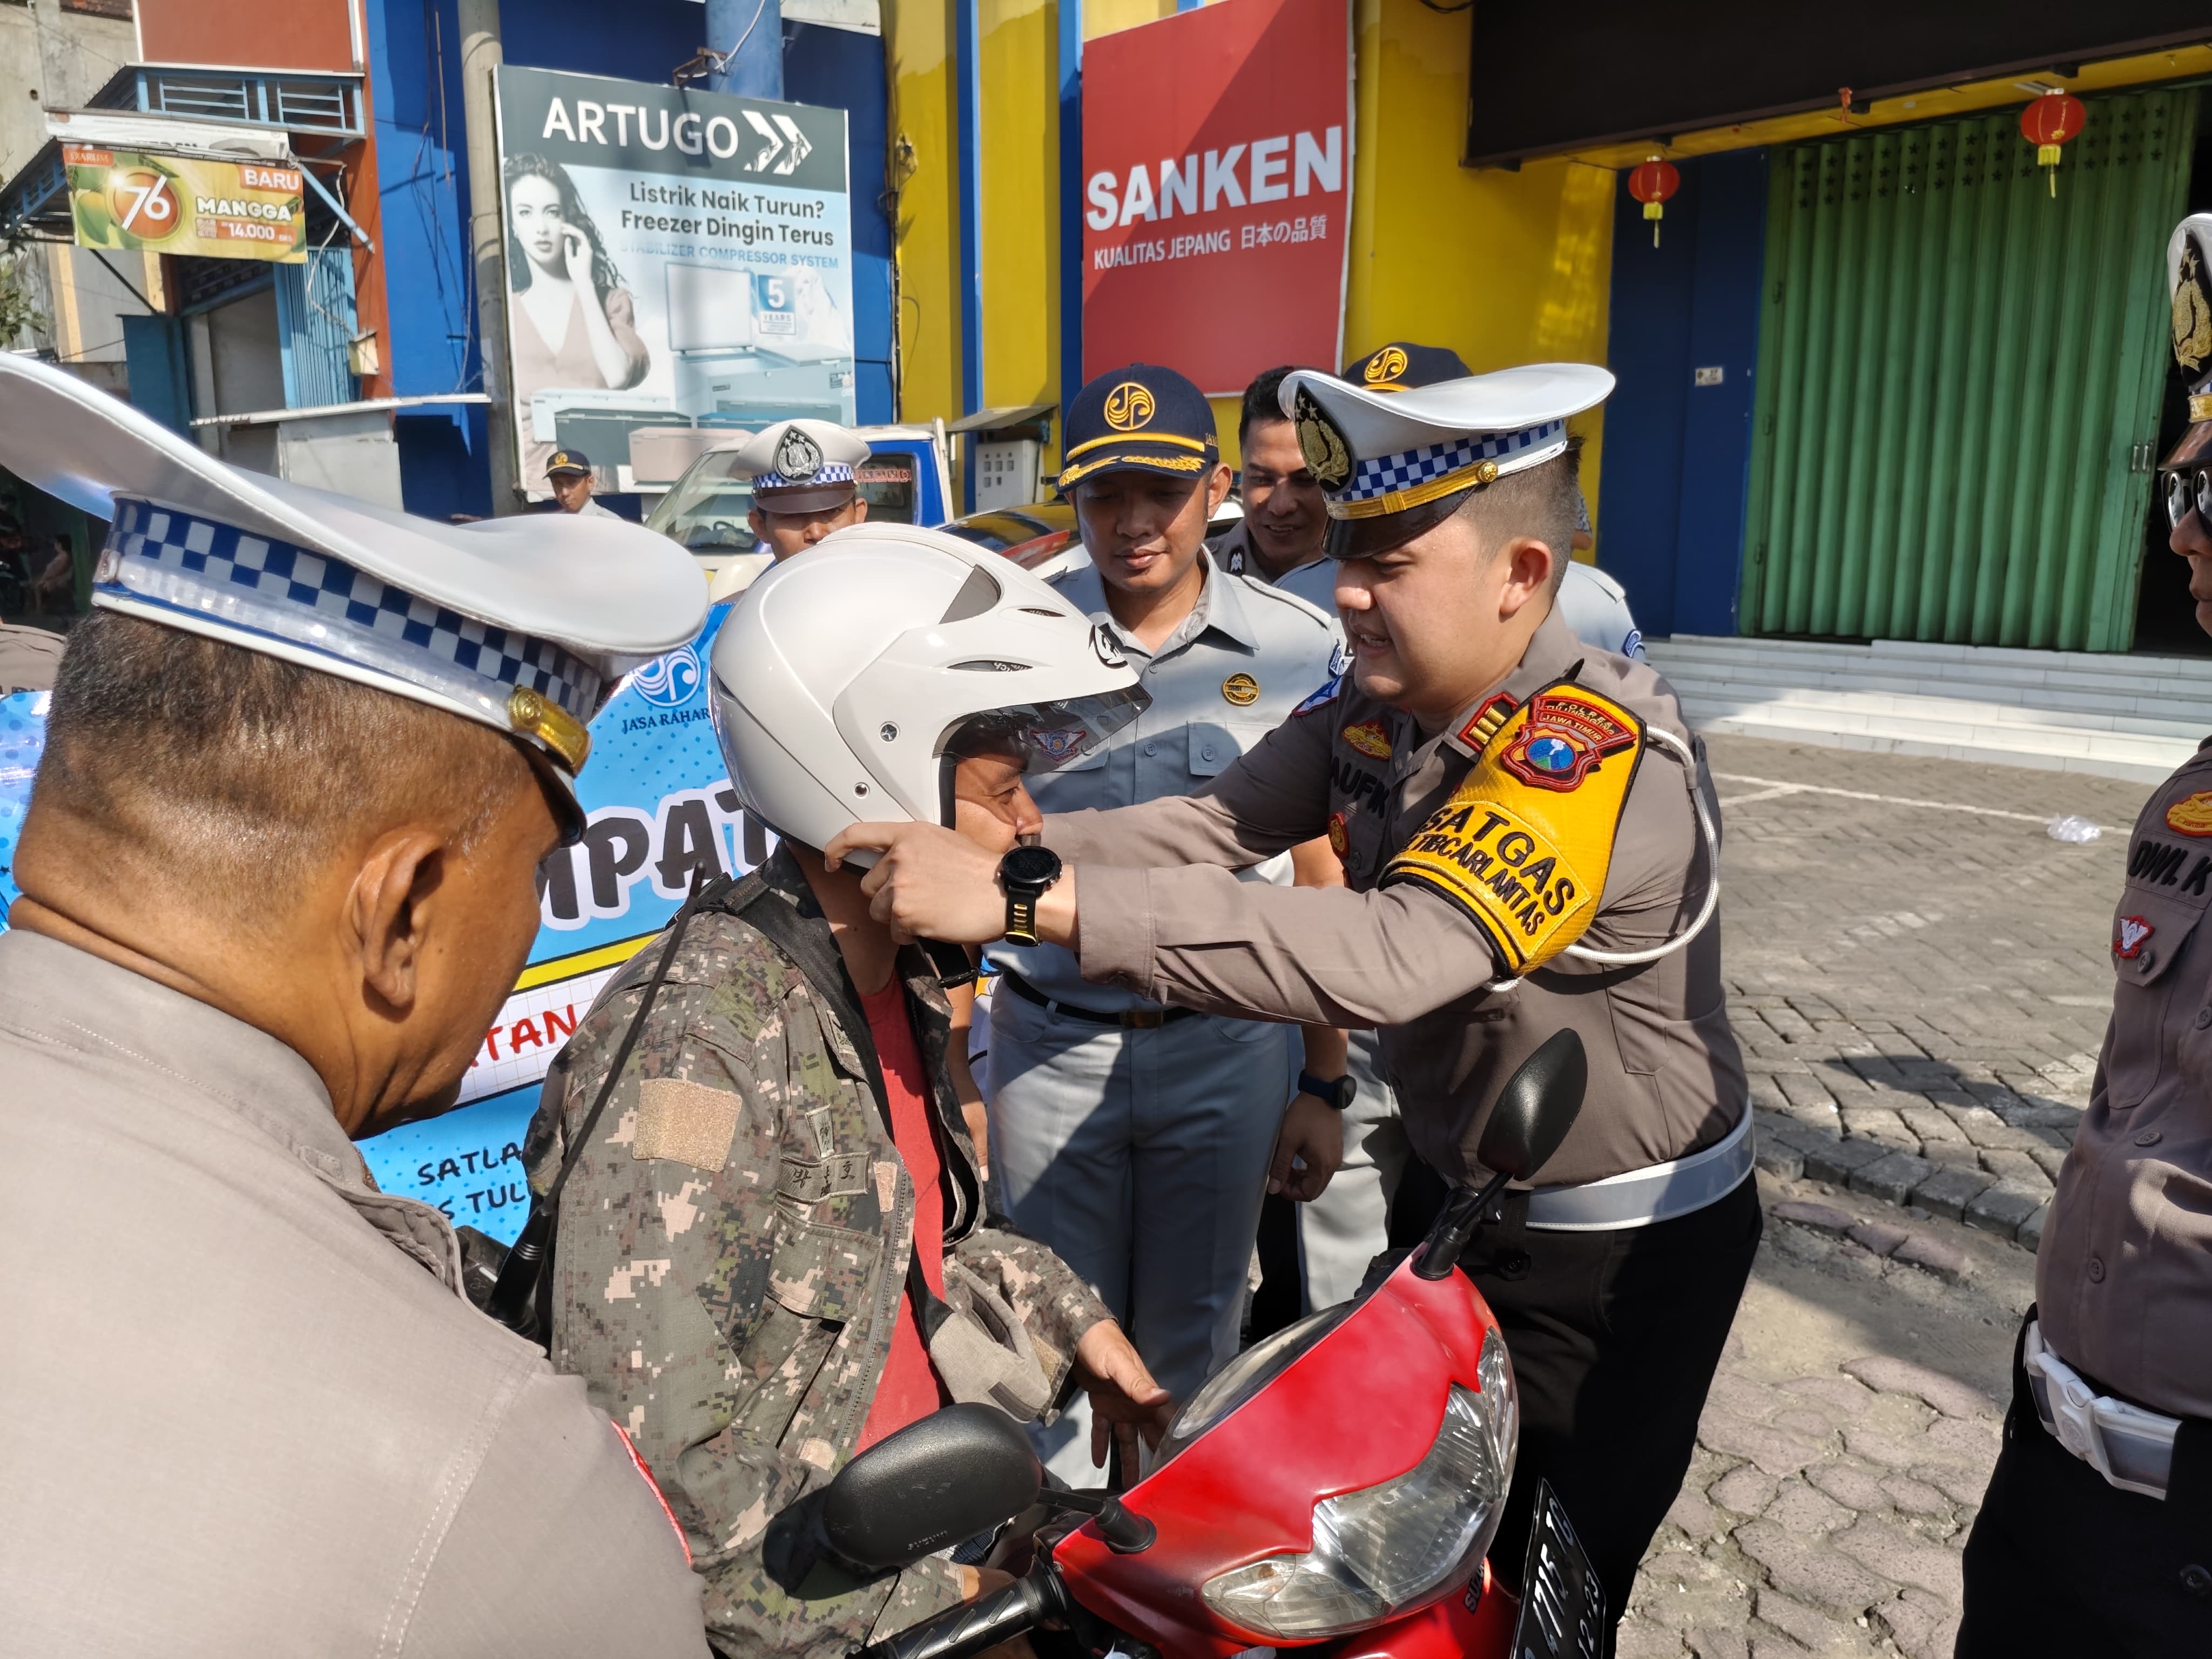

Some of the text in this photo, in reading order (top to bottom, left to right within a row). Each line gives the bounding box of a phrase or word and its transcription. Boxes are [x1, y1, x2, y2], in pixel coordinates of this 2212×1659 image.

[542, 97, 739, 158] ARTUGO
[244, 168, 299, 190] BARU
[1086, 126, 1342, 231] SANKEN
[122, 174, 171, 231] 76
[196, 197, 293, 221] MANGGA
[630, 182, 825, 219] Listrik Naik Turun?
[228, 222, 275, 241] 14.000
[622, 210, 834, 246] Freezer Dingin Terus
[1240, 214, 1328, 250] 日本の品質
[620, 241, 838, 269] STABILIZER COMPRESSOR SYSTEM
[1094, 230, 1231, 270] KUALITAS JEPANG
[768, 279, 785, 308] 5
[622, 716, 657, 735] JASA
[1542, 714, 1603, 742] JAWA TIMUR
[1421, 805, 1575, 916] SATGAS
[471, 1004, 578, 1068] TAN
[417, 1142, 522, 1186] SATLA
